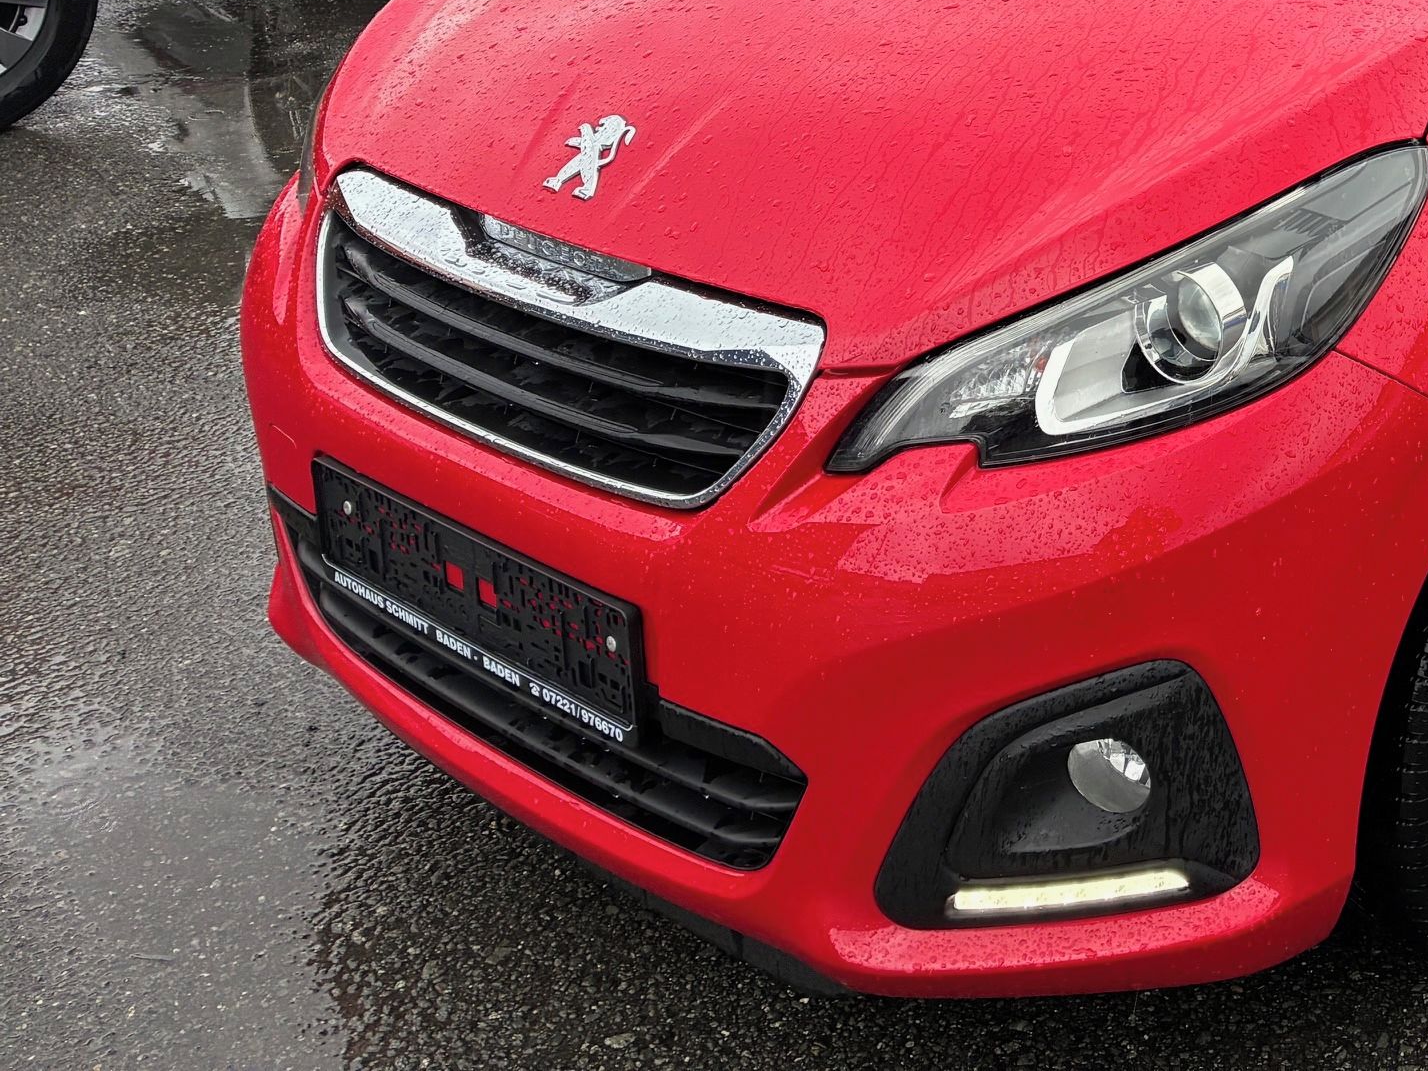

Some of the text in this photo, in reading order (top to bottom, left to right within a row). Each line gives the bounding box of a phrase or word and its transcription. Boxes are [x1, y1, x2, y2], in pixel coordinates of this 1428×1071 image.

[334, 570, 386, 609] AUTOHAUS
[385, 600, 429, 635] SCHMITT
[436, 628, 472, 662] BADEN
[482, 655, 521, 688] BADEN
[542, 688, 624, 743] 07221/976670
